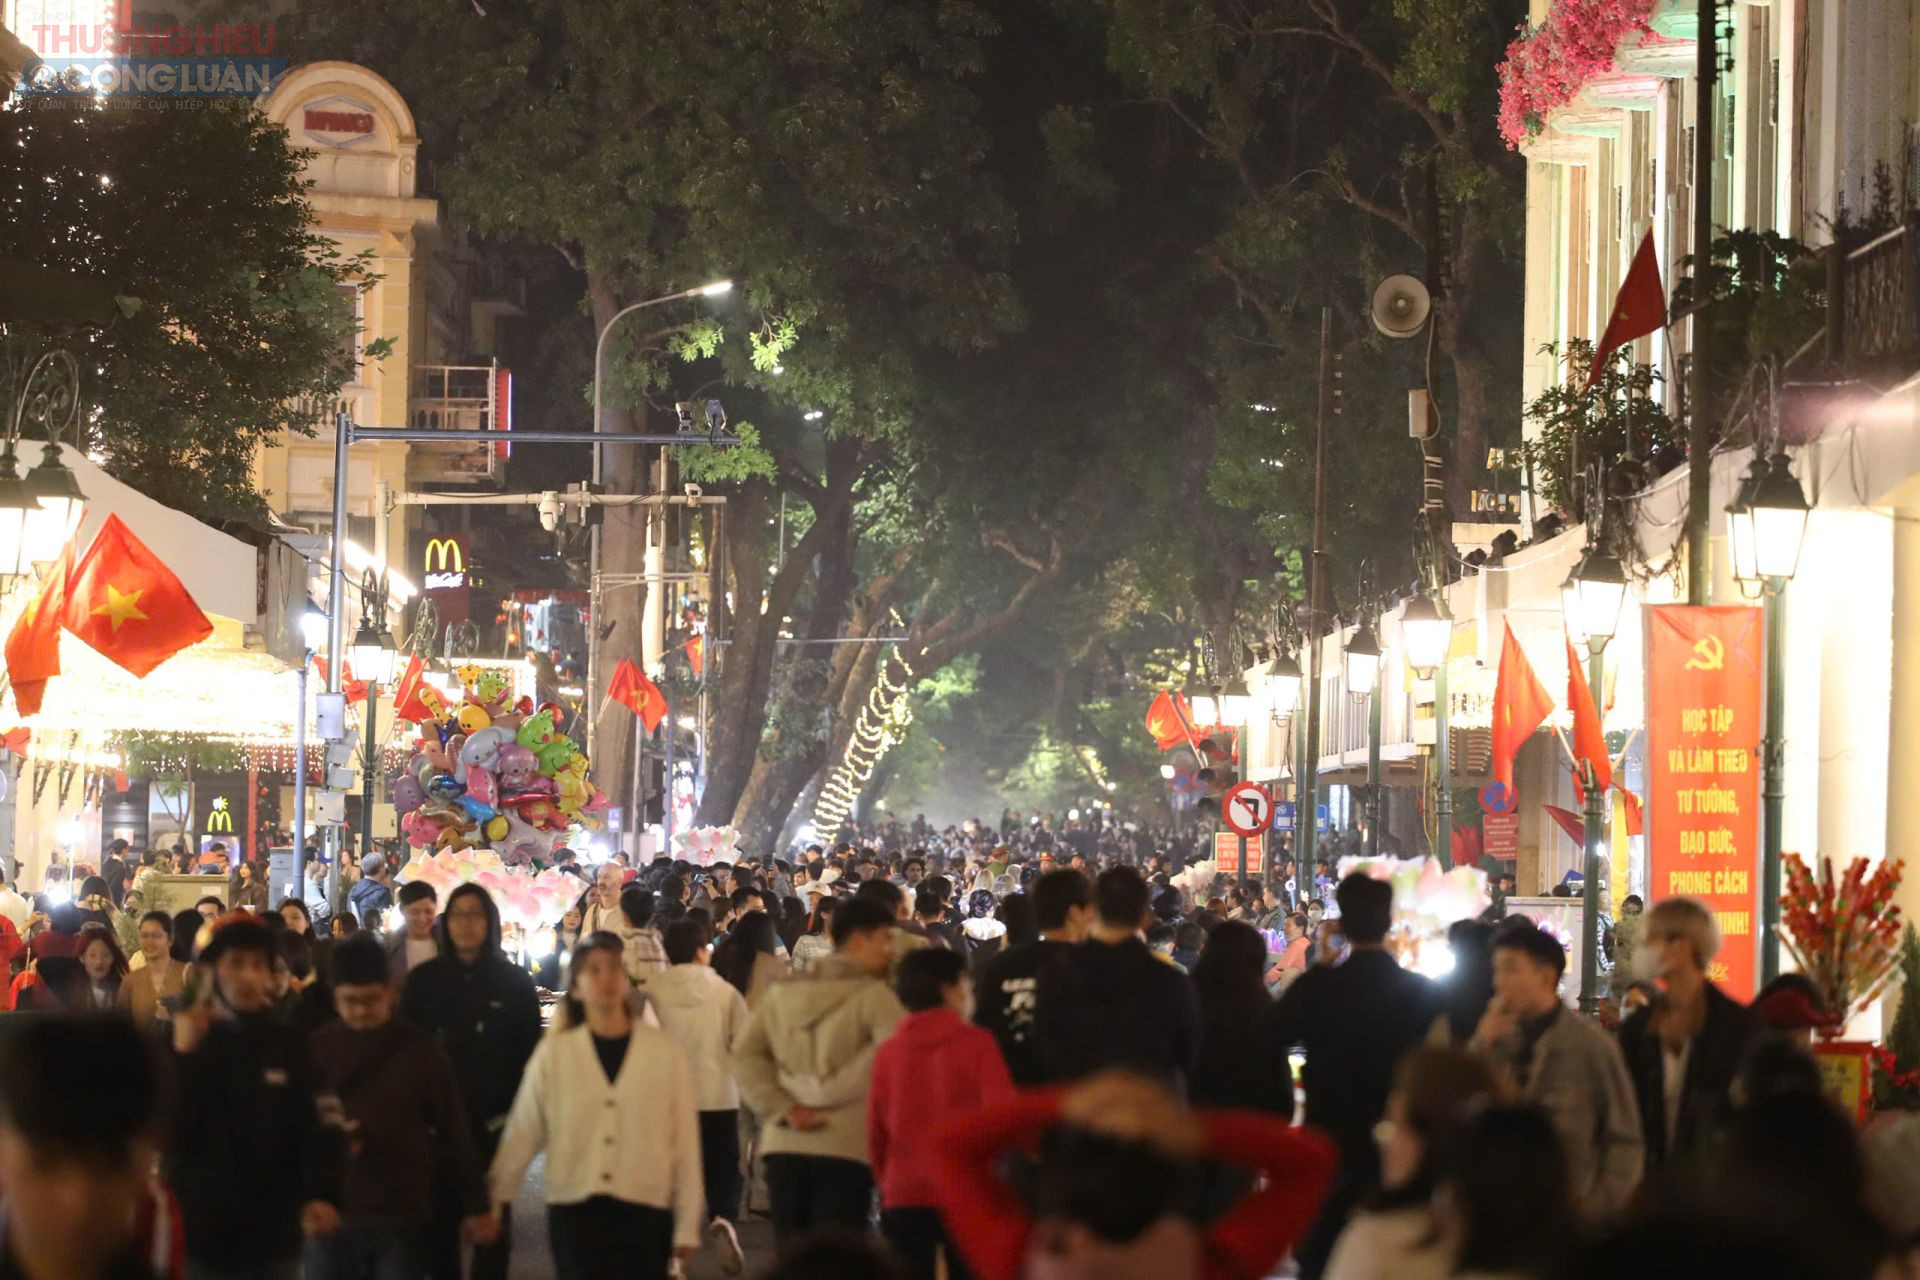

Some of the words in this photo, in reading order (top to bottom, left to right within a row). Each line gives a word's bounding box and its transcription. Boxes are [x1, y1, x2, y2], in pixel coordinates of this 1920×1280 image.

[1682, 709, 1707, 737] HỌC
[1710, 704, 1734, 737] TẬP
[1668, 745, 1684, 773] VÀ
[1687, 745, 1714, 773] LÀM
[1716, 748, 1748, 773] THEO
[1677, 790, 1694, 814] TƯ
[1680, 830, 1705, 858] ĐẠO
[1669, 871, 1712, 895] PHONG
[1714, 866, 1748, 895] CÁCH
